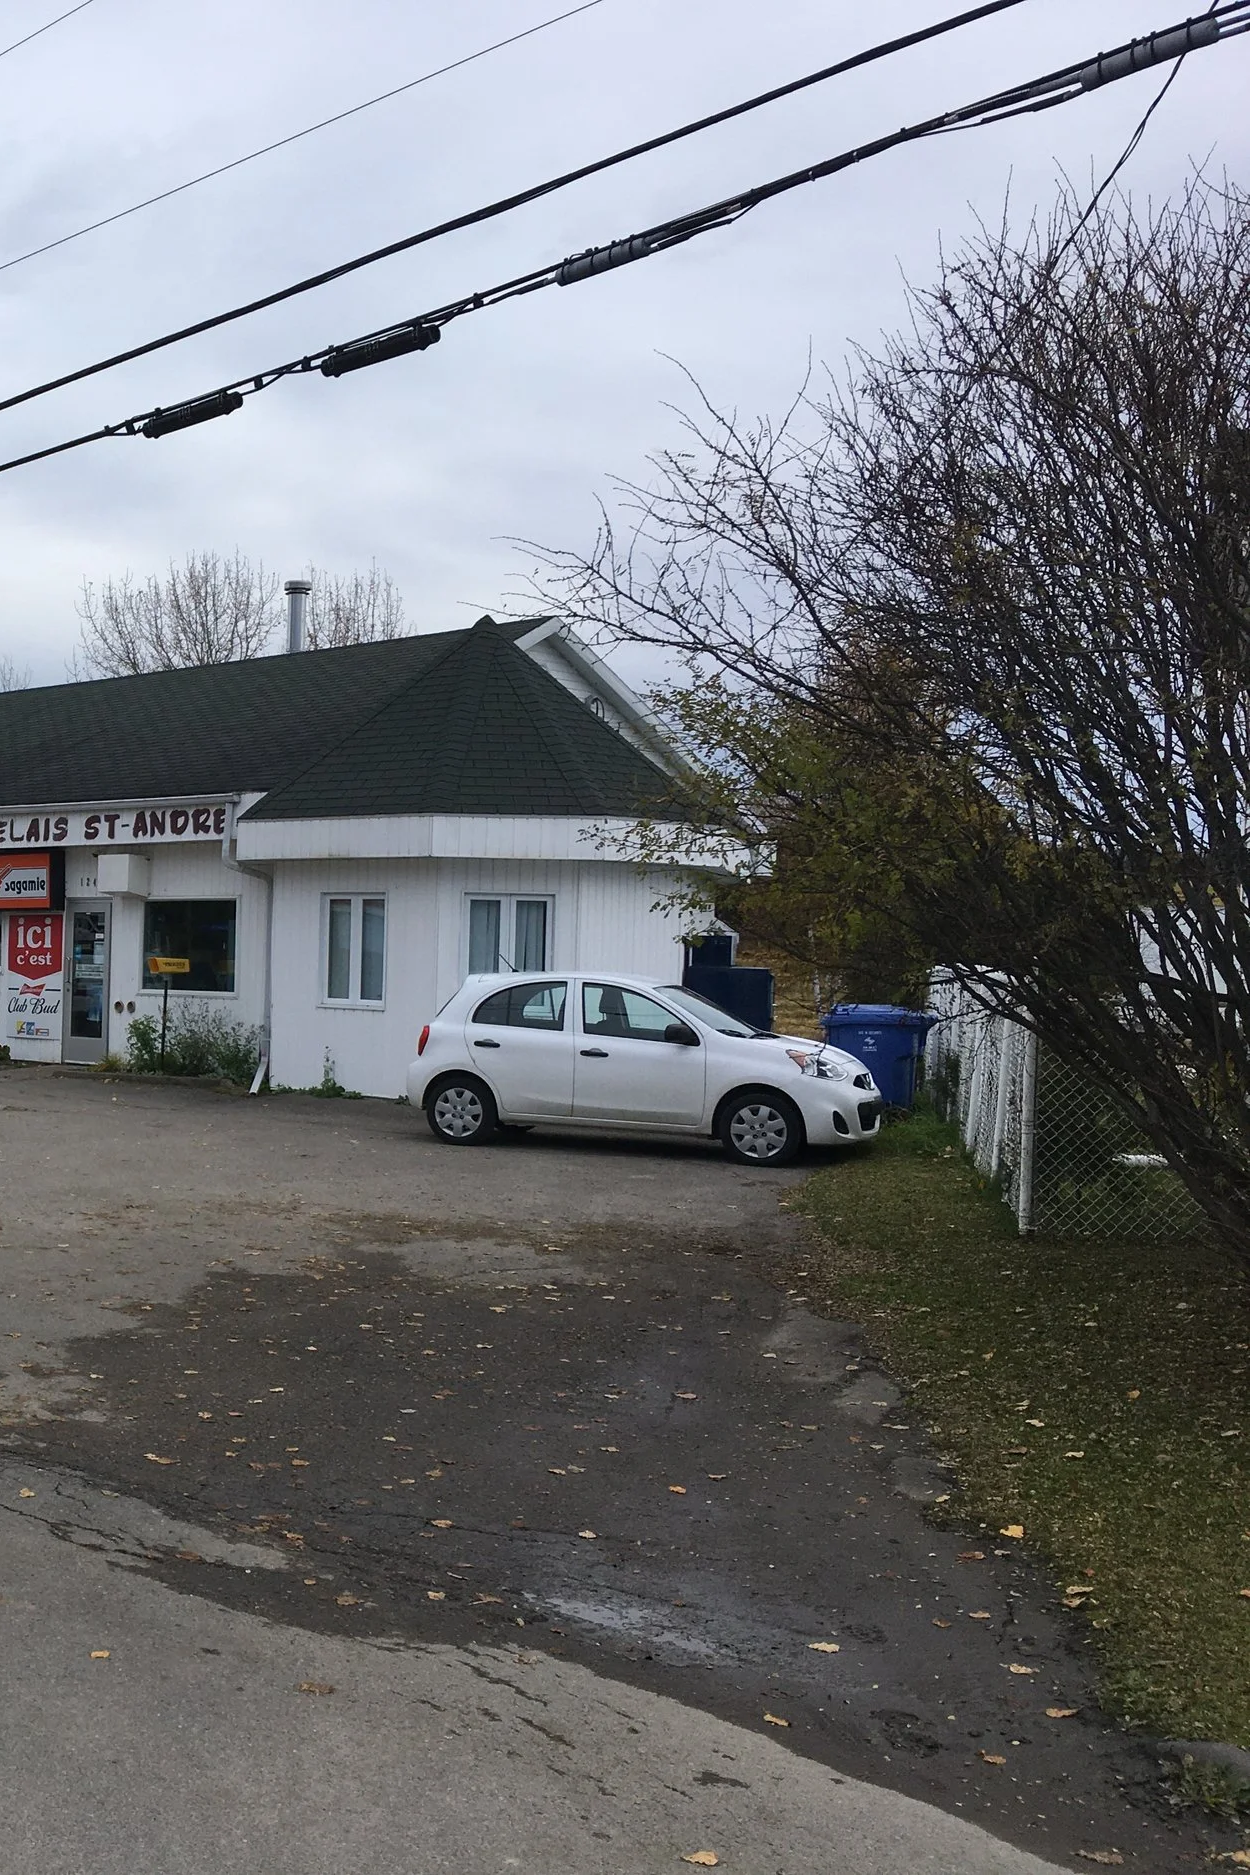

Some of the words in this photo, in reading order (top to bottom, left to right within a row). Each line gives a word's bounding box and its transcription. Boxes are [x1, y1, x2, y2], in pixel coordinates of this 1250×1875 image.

[16, 917, 53, 949] ici
[16, 950, 53, 966] c'est
[7, 996, 28, 1014] Club
[30, 997, 61, 1015] Bud
